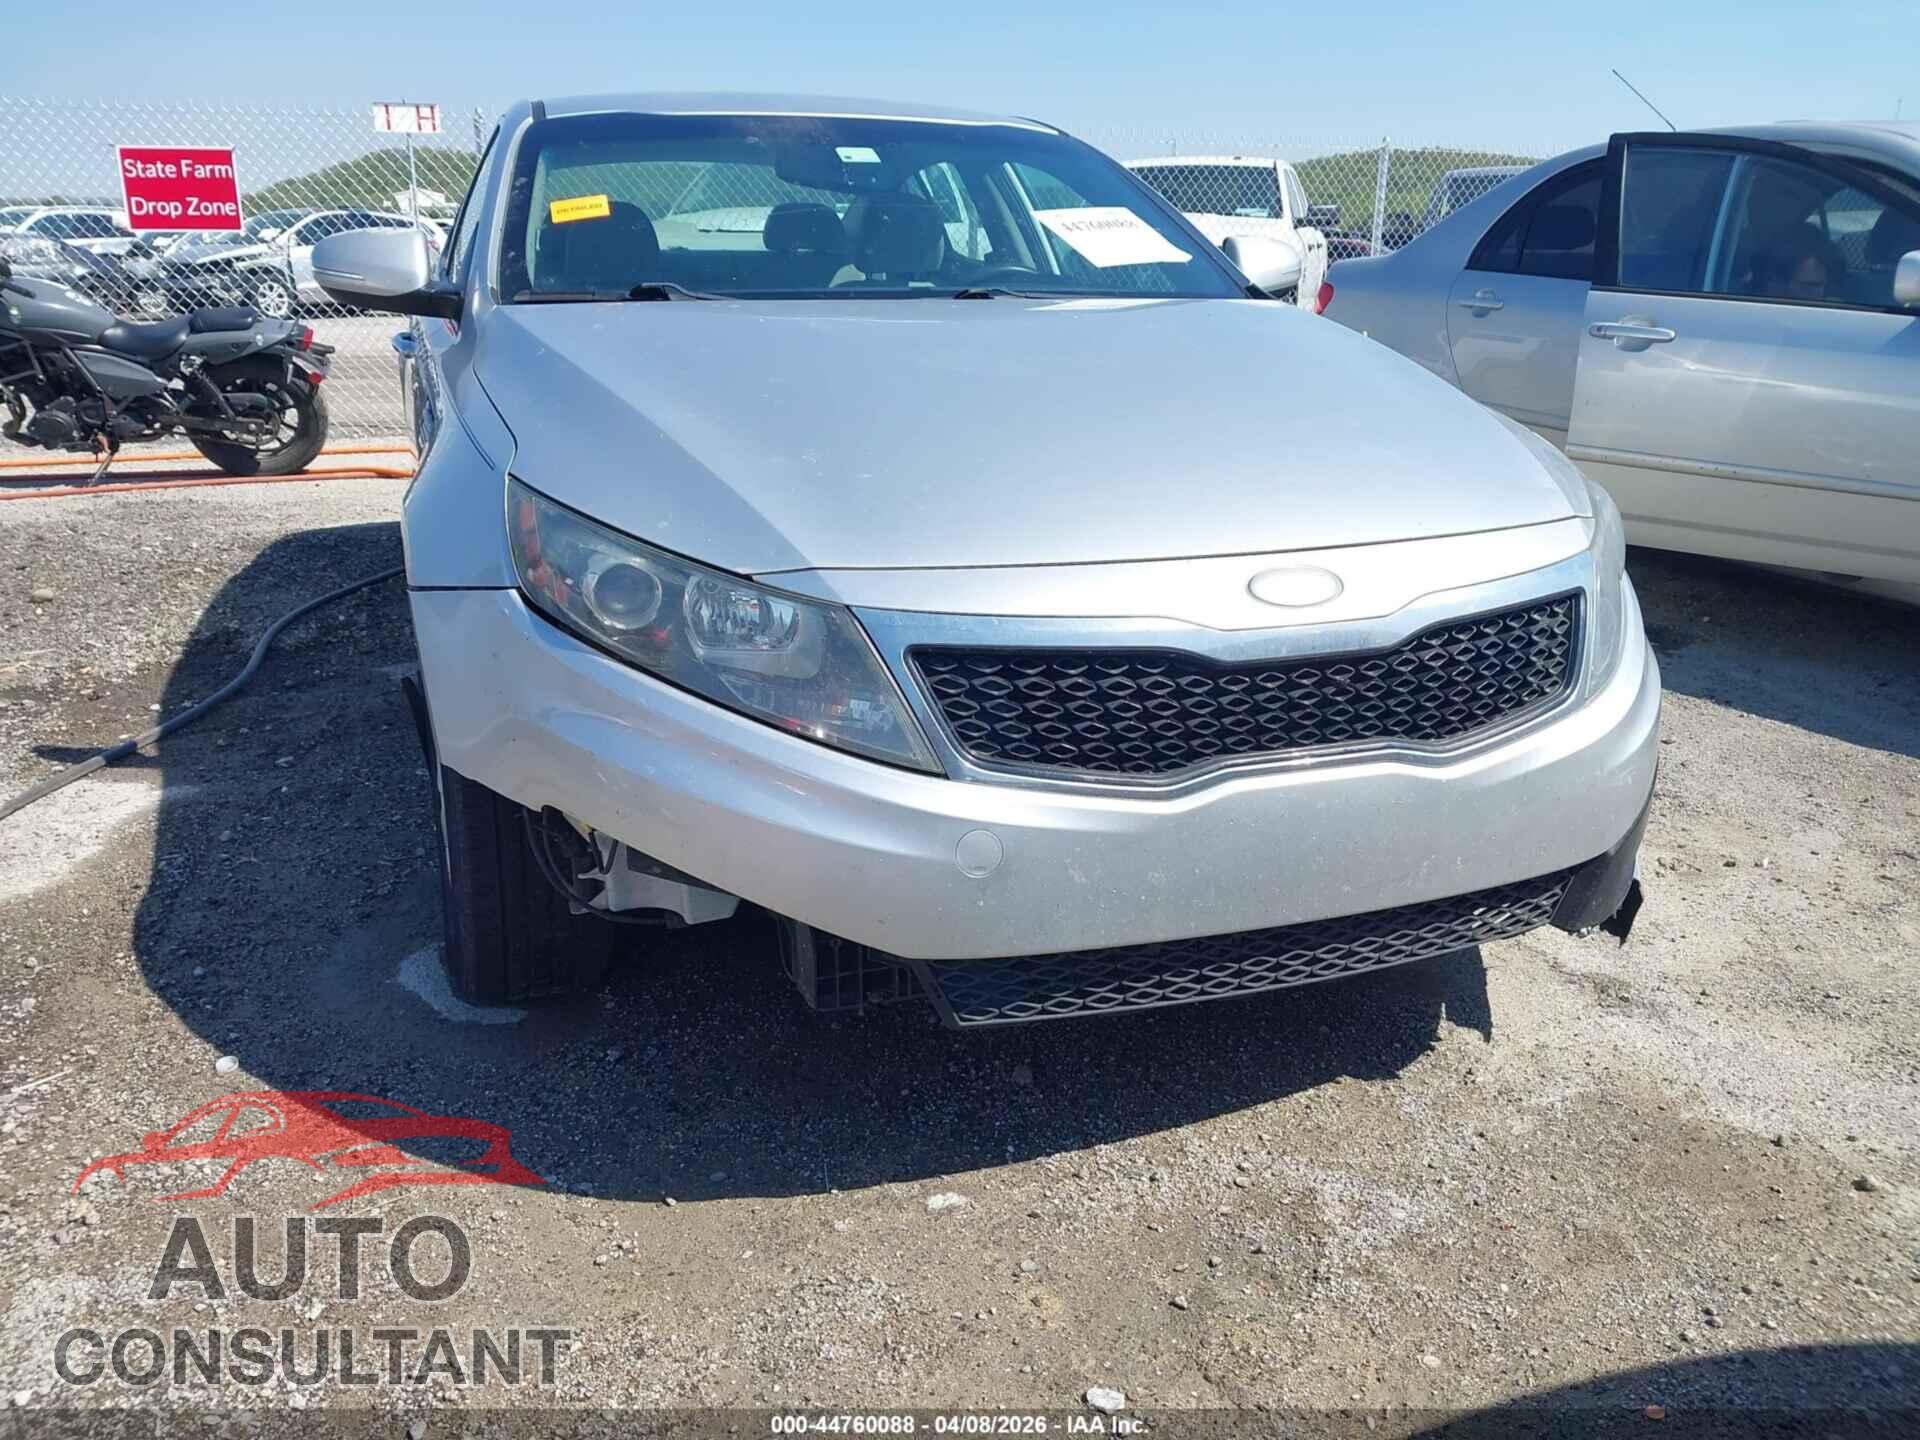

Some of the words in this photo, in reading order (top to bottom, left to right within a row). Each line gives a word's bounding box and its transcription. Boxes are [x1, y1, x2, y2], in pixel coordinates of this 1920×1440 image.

[123, 159, 178, 179] State
[180, 159, 233, 179] Farm
[130, 196, 183, 219] Drop
[185, 196, 238, 217] Zone
